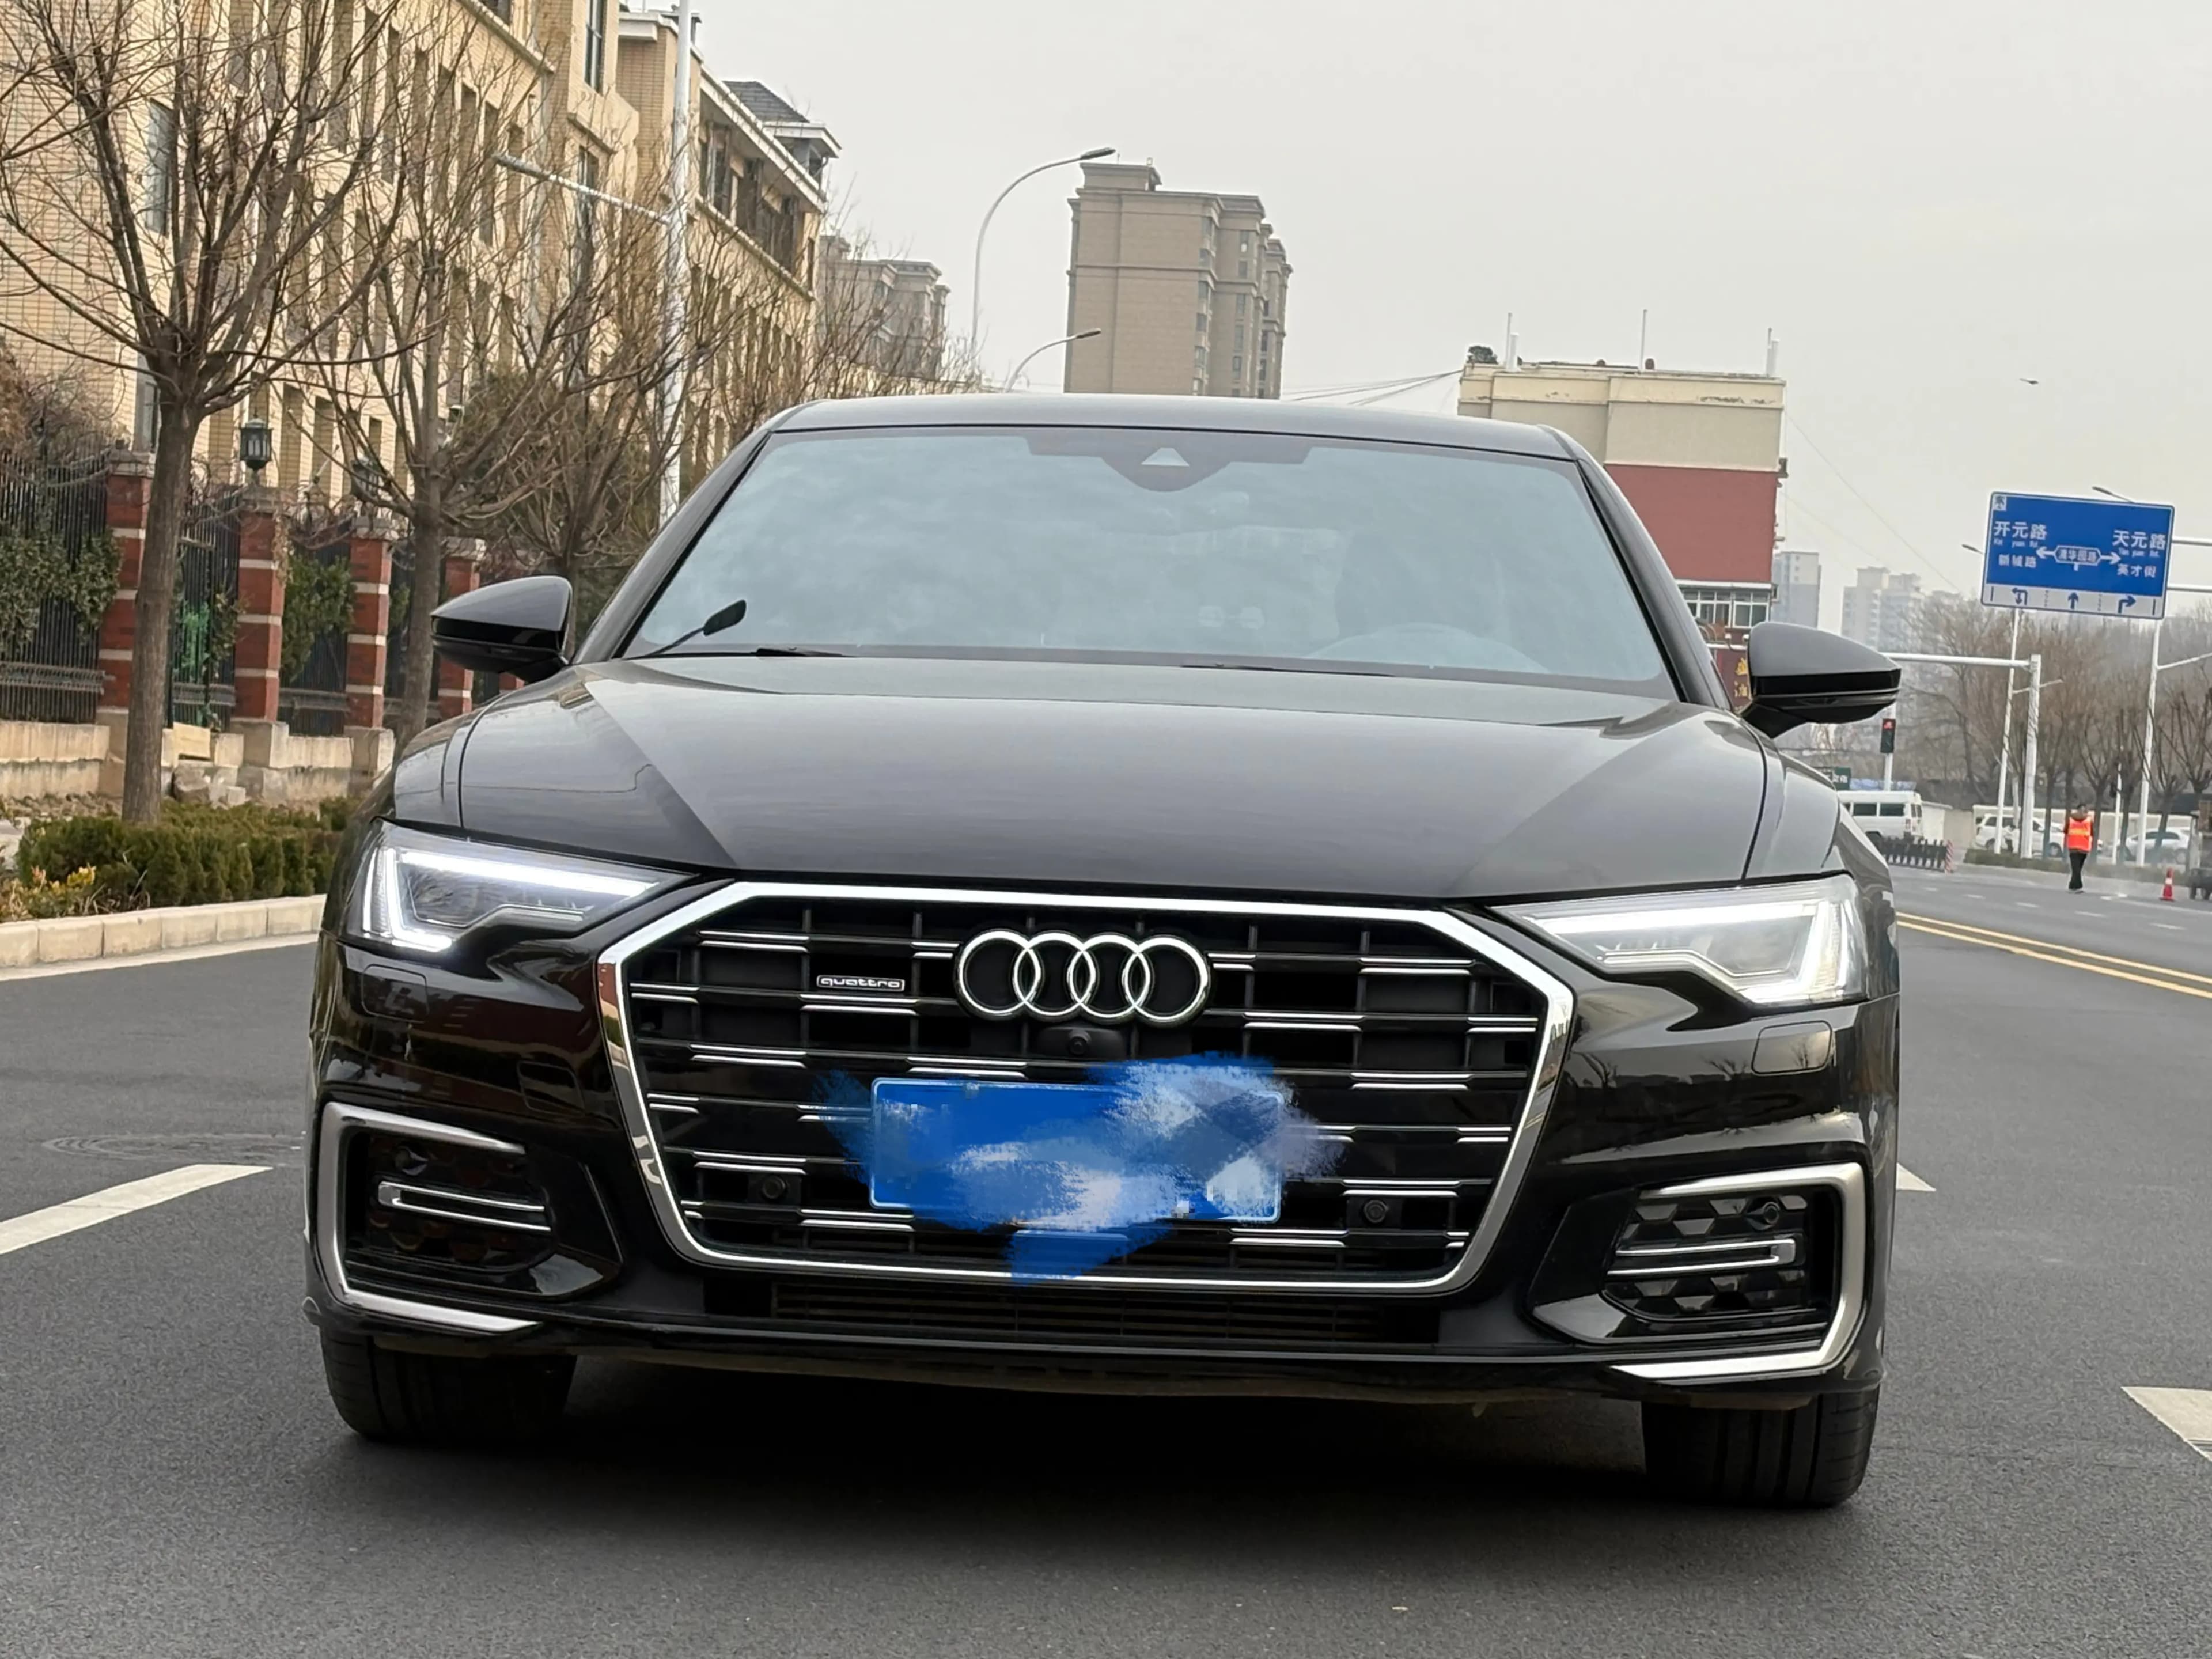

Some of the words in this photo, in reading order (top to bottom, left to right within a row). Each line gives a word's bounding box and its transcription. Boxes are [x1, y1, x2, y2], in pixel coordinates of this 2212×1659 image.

[1994, 521, 2047, 540] 开元路
[2112, 530, 2165, 550] 天元路
[2117, 564, 2157, 578] 英才街
[820, 977, 900, 988] quattro
